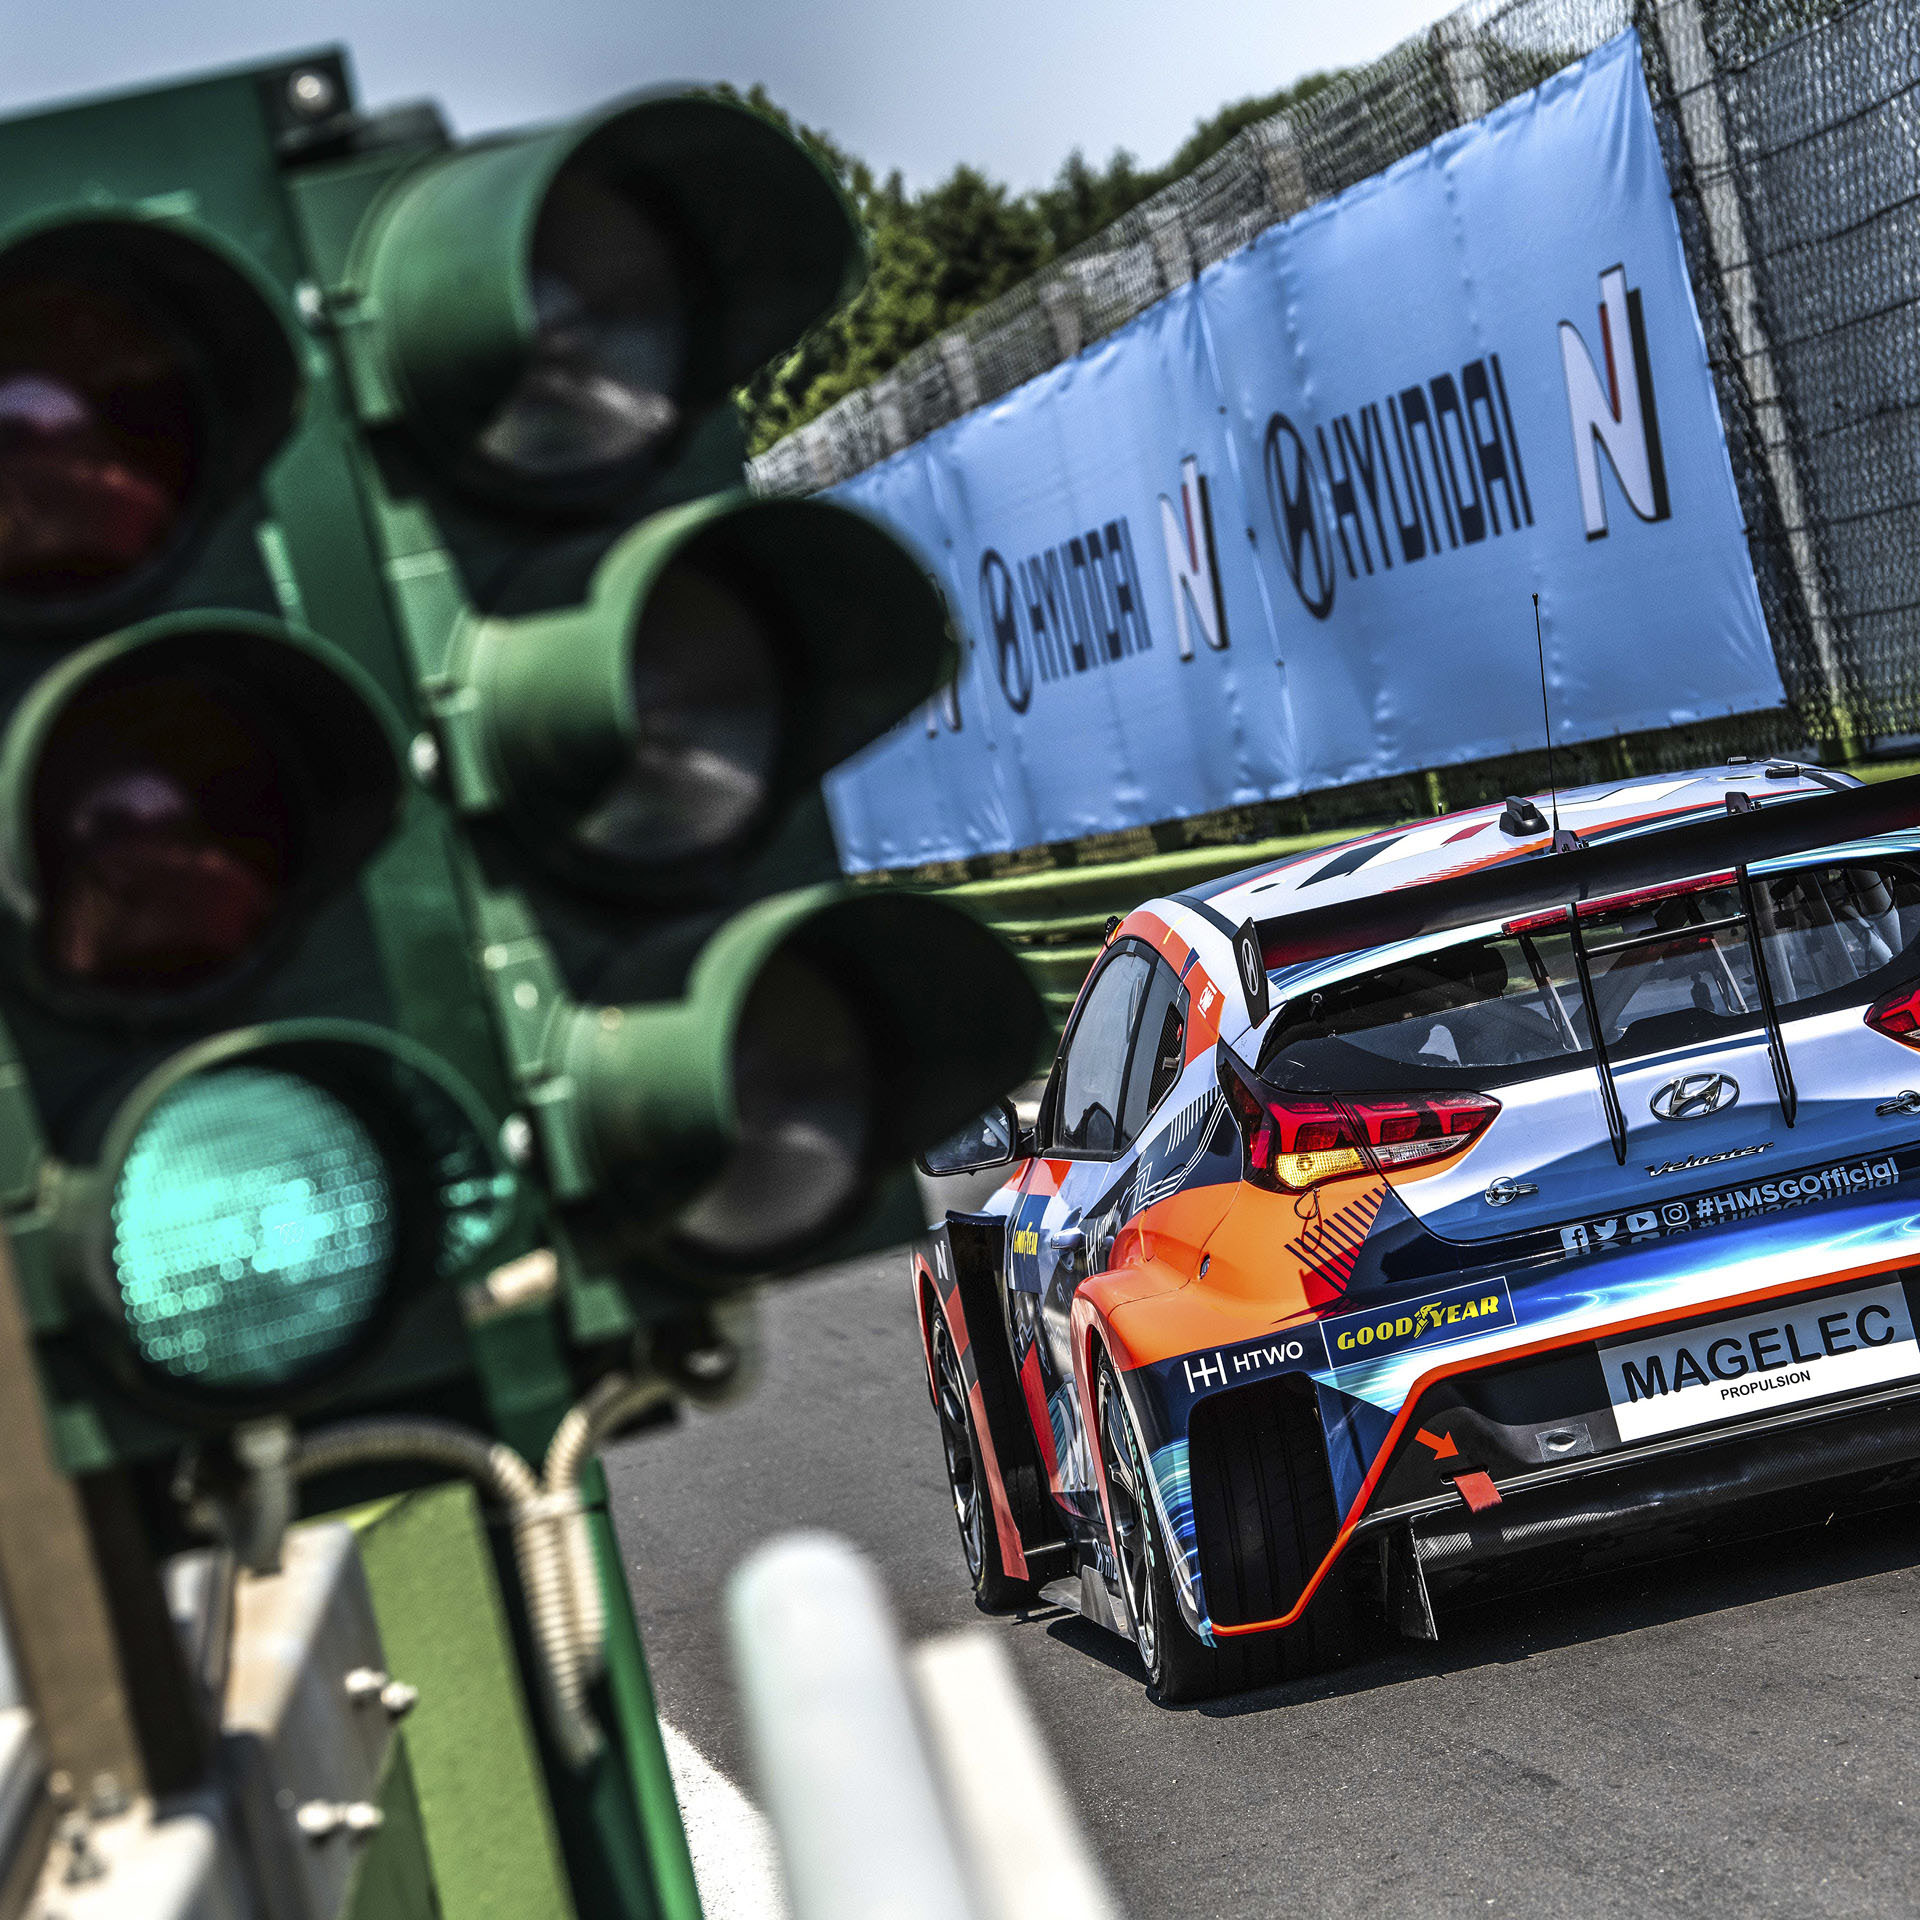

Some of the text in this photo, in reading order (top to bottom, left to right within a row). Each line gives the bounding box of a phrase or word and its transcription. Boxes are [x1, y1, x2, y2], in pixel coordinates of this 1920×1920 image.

[1316, 262, 1672, 580] HYUNDAI N
[1017, 454, 1230, 684] HYUNDAI N
[1645, 1141, 1775, 1177] Veloster
[1695, 1157, 1900, 1218] #HMSGOfficial
[1232, 1341, 1304, 1374] HTWO
[1621, 1304, 1895, 1404] MAGELEC
[1720, 1370, 1811, 1401] PROPULSION
